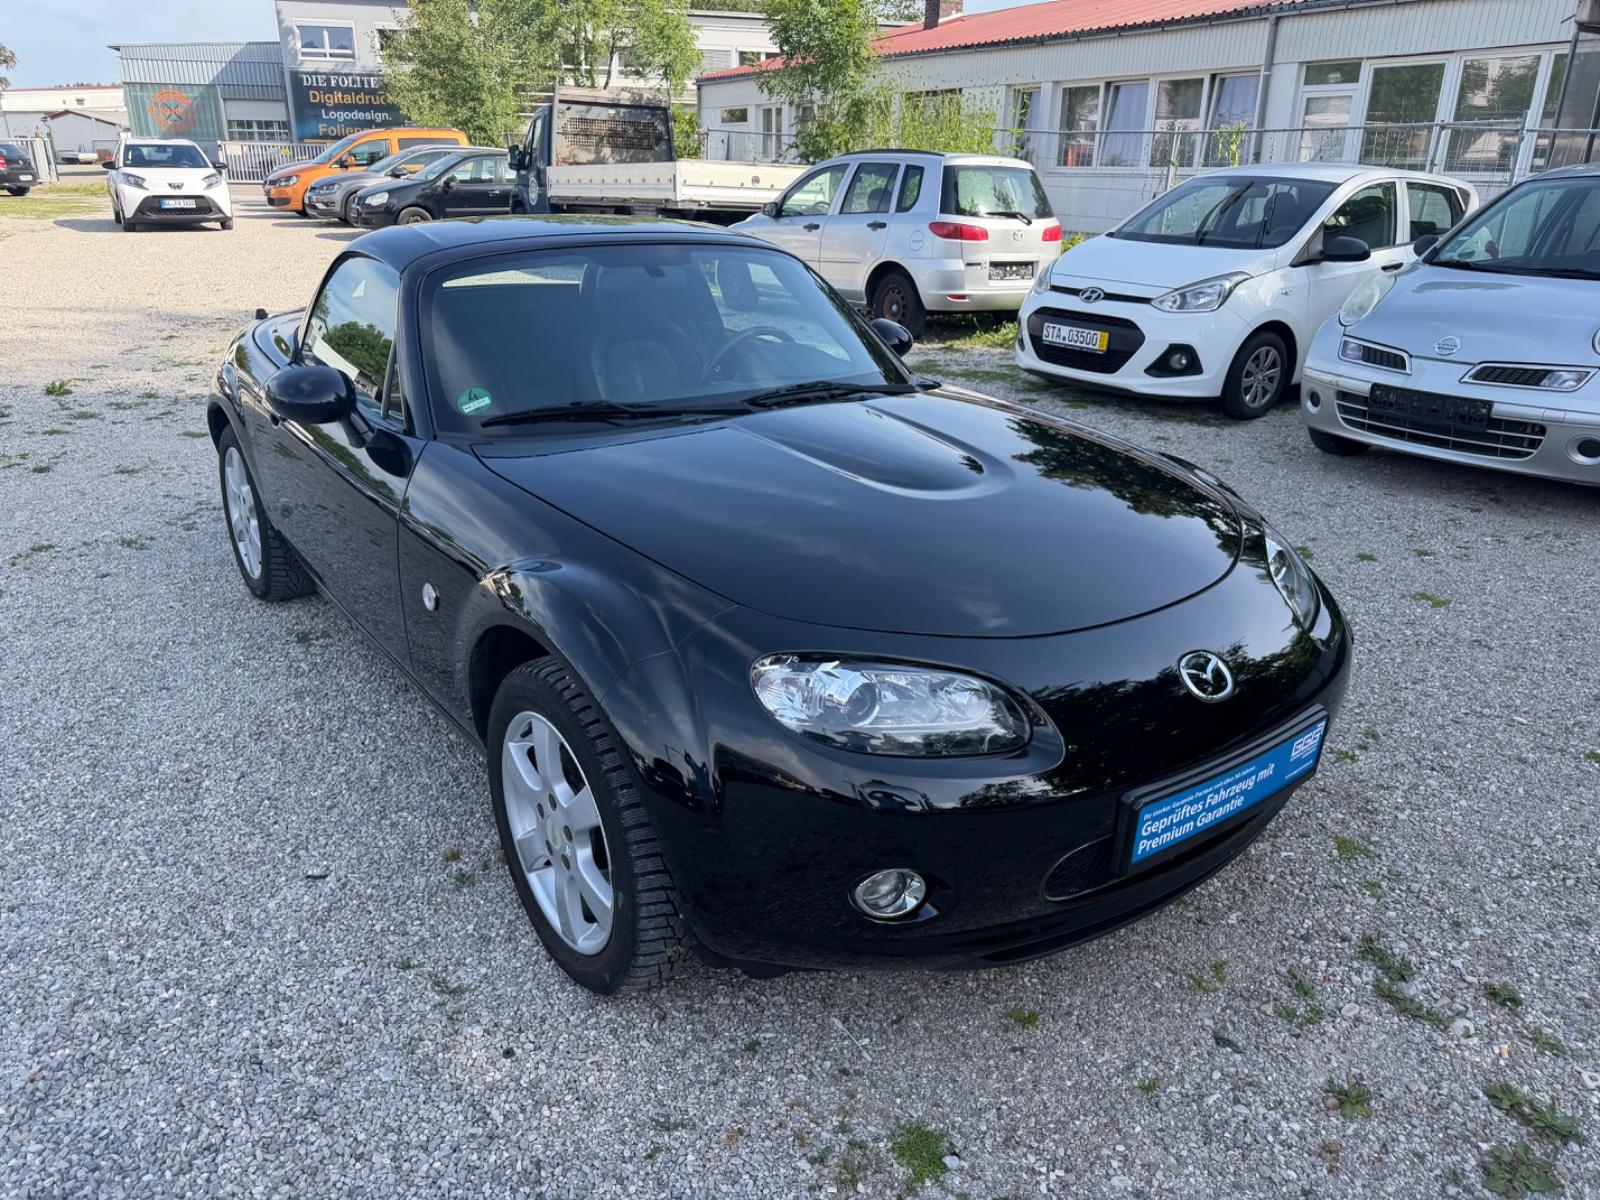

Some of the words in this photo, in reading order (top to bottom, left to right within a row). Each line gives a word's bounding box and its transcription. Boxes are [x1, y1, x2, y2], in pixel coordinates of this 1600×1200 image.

[303, 74, 327, 87] DIE
[329, 75, 380, 89] FOLITE
[308, 89, 390, 107] Digitaldruc
[321, 109, 392, 123] Logodesign.
[1044, 325, 1061, 341] STA
[1067, 328, 1099, 347] 03500
[1141, 801, 1204, 837] Geprüftes
[1205, 774, 1255, 808] Fahrzeug
[1256, 762, 1275, 782] mit
[1137, 820, 1194, 855] Premium
[1196, 795, 1245, 828] Garantie
